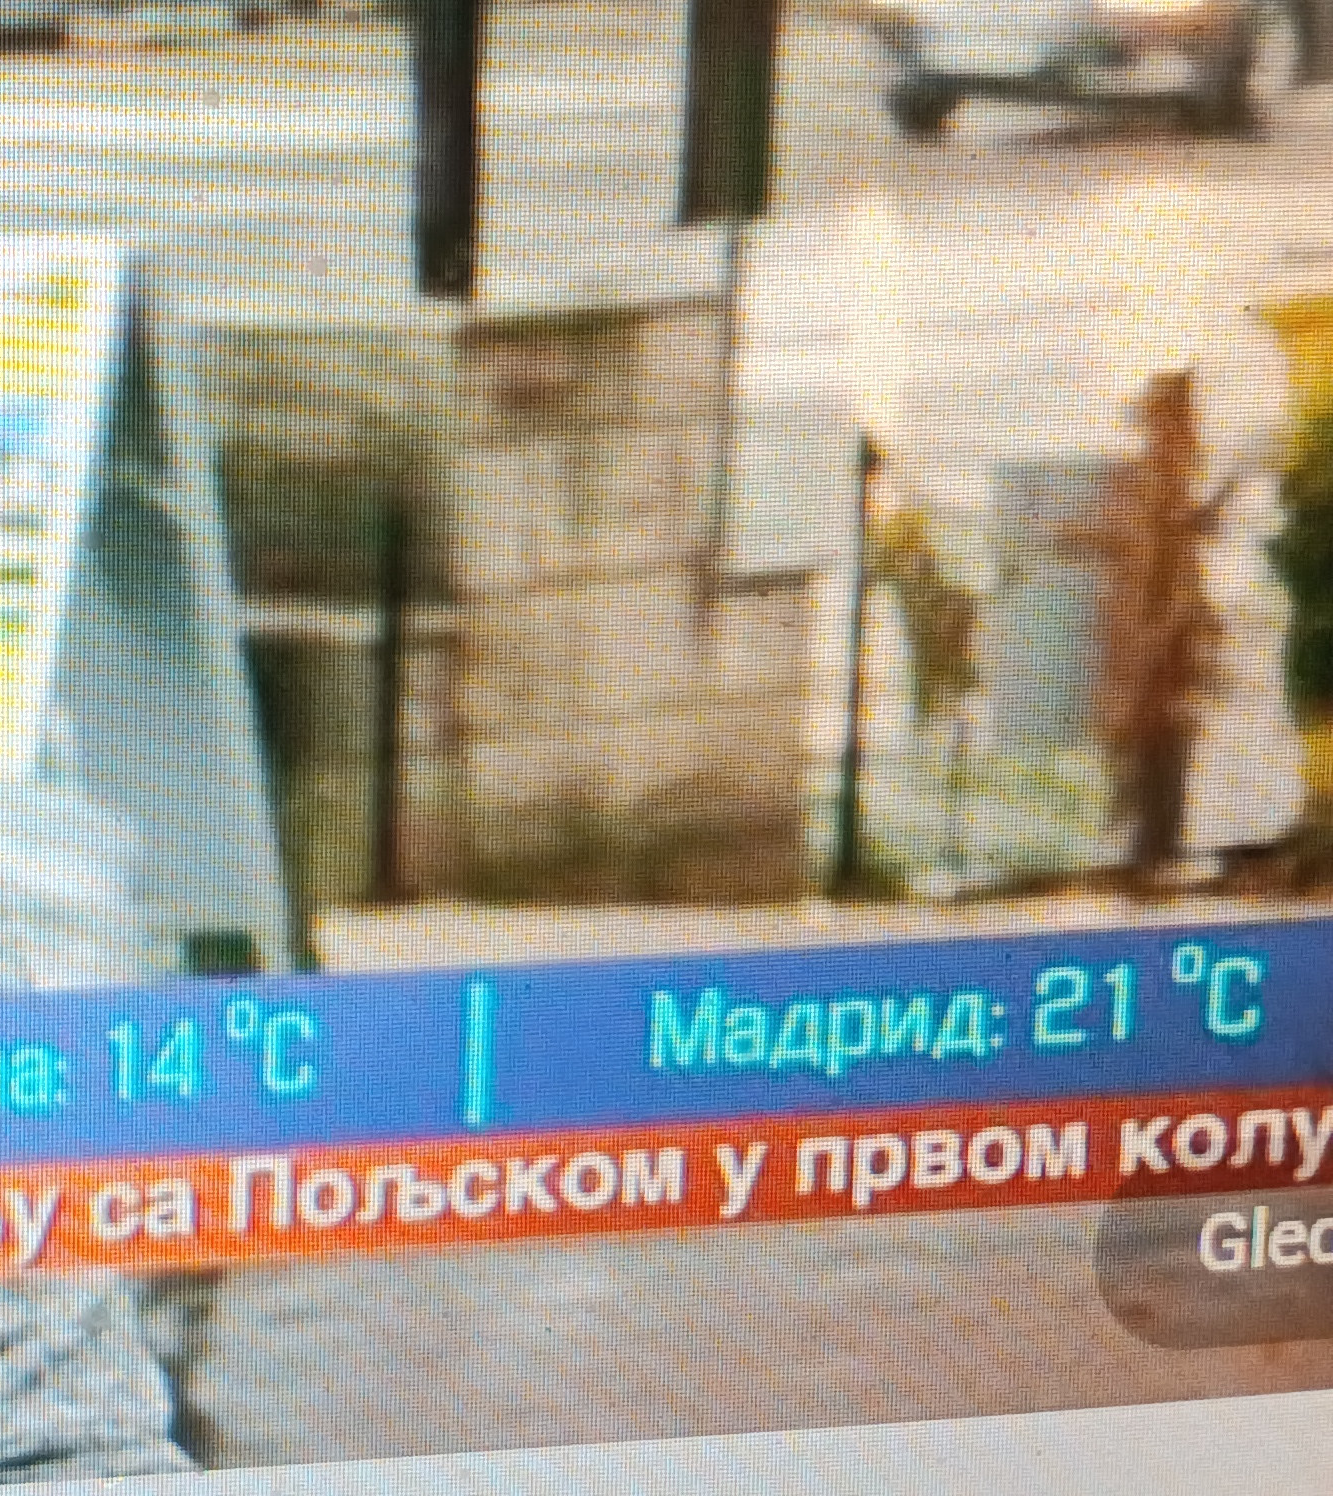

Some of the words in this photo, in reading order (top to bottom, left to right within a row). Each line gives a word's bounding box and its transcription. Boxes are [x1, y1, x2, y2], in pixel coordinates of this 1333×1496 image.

[107, 1016, 203, 1101] 14
[648, 985, 1007, 1077] Мадрид:
[1030, 963, 1137, 1047] 21
[88, 1176, 197, 1242] са
[229, 1149, 685, 1233] Пољском
[715, 1140, 767, 1217] у
[793, 1121, 1089, 1210] првом
[1119, 1106, 1333, 1183] колу
